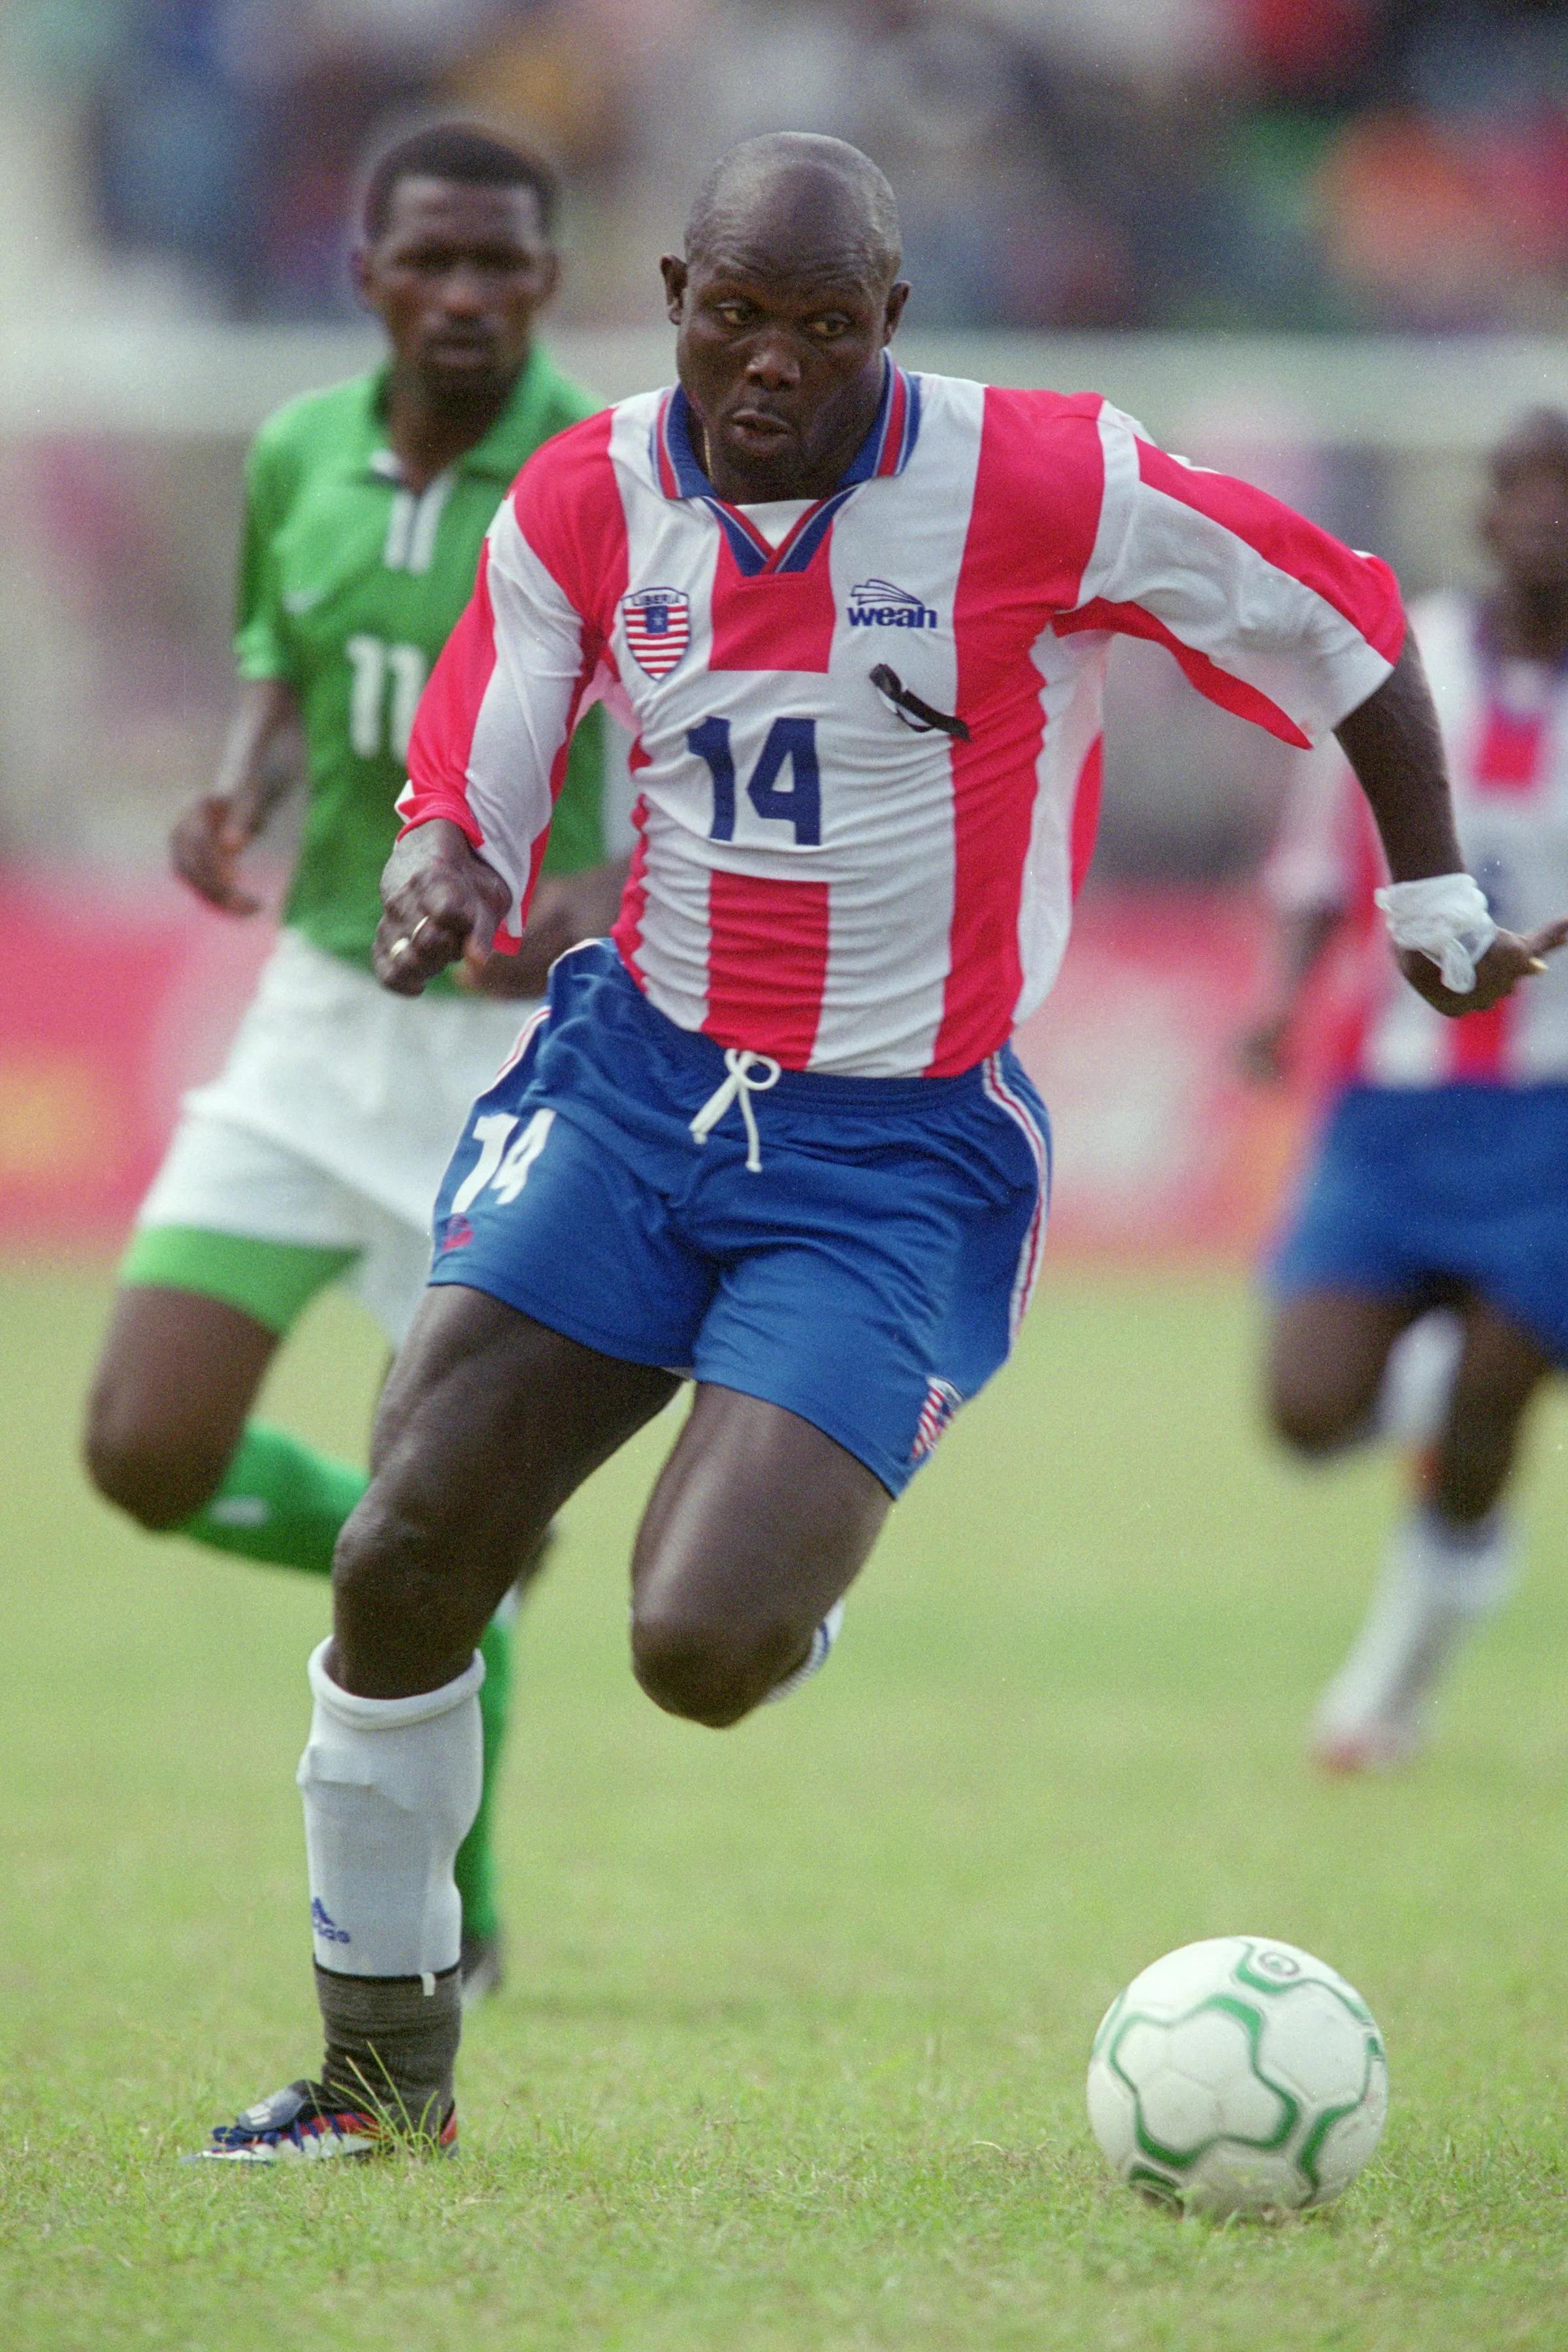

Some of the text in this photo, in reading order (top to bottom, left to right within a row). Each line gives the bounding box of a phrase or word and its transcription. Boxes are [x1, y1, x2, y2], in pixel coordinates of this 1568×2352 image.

[847, 606, 937, 629] weah
[686, 715, 821, 847] 14
[449, 1107, 557, 1214] 14
